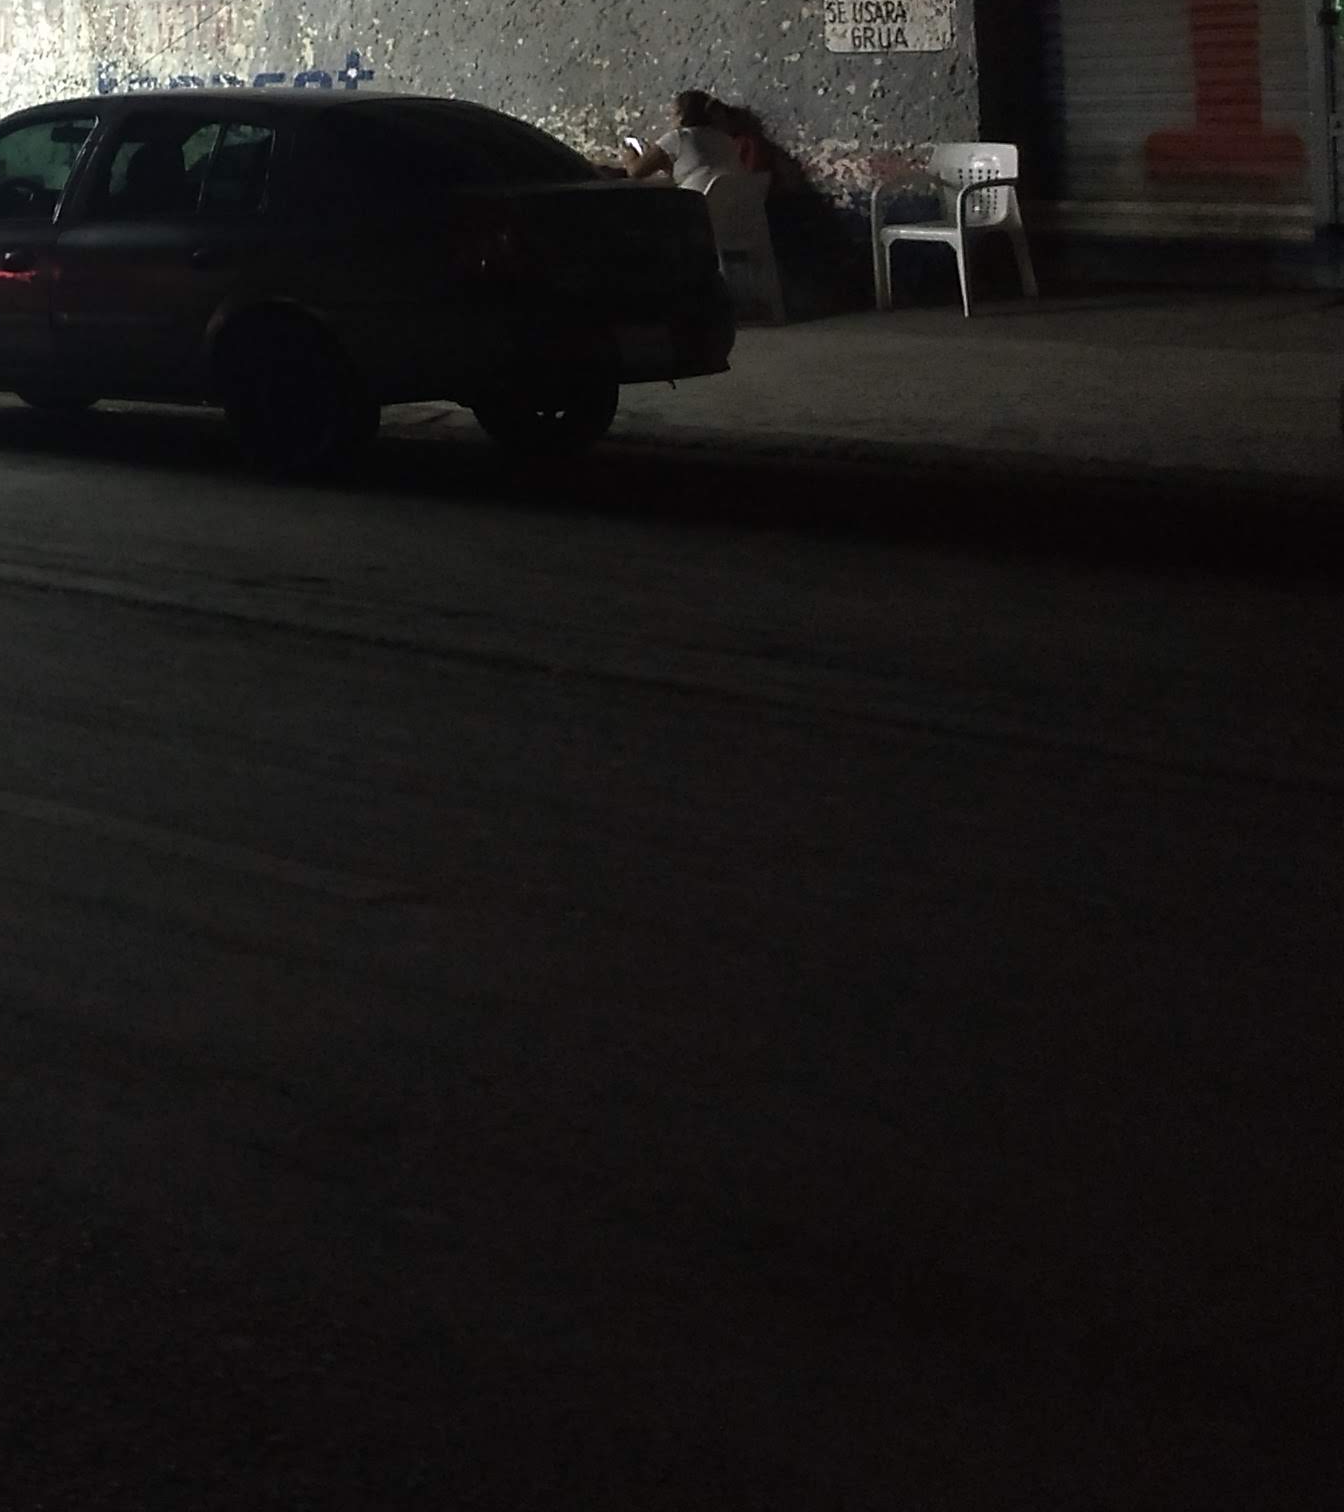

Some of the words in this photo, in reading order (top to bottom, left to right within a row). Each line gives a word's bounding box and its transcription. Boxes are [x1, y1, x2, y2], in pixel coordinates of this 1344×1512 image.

[826, 1, 848, 24] SE
[852, 0, 908, 24] USARA
[851, 27, 909, 49] GRUA
